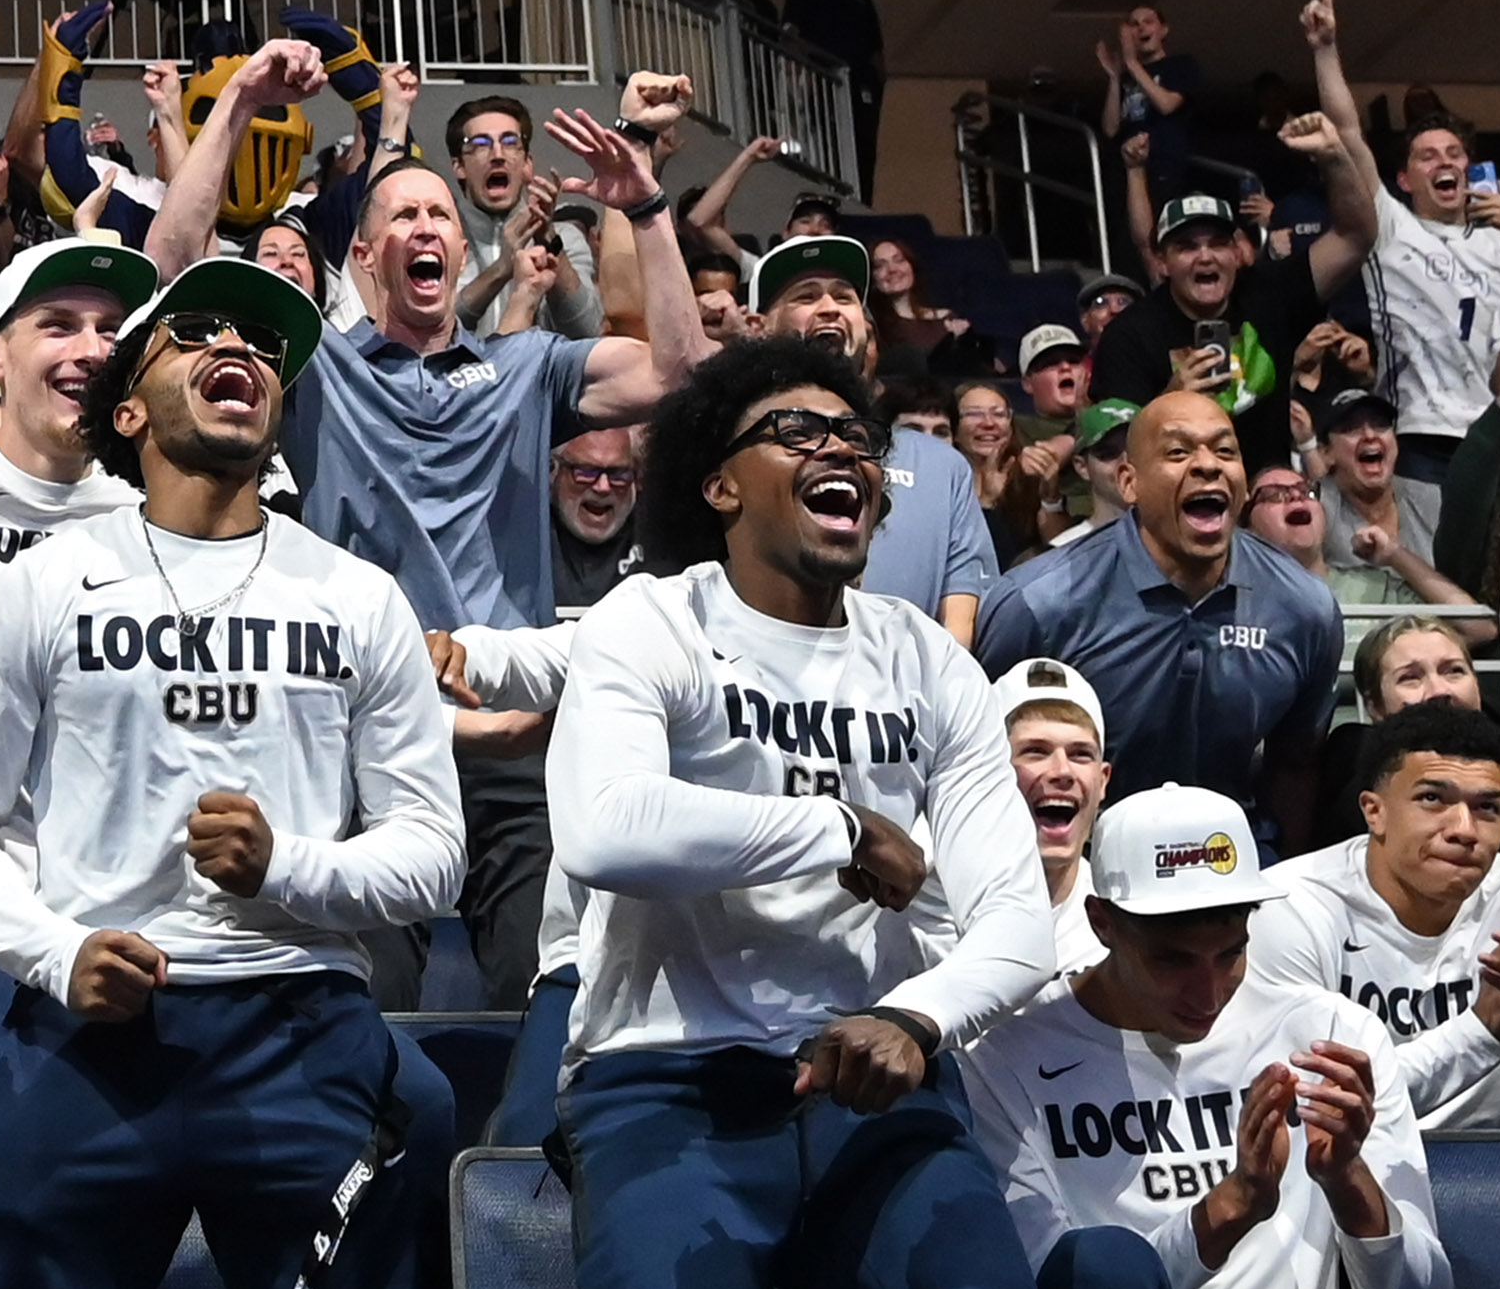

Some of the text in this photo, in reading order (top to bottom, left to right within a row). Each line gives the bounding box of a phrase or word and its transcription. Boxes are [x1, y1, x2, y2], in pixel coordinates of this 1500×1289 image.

[1294, 223, 1322, 235] CBU
[1459, 298, 1475, 341] 1
[447, 362, 497, 388] CBU
[77, 614, 353, 680] LOCK IT IN.
[1219, 624, 1268, 650] CBU
[164, 683, 258, 724] CBU
[723, 683, 836, 759] LOCK
[865, 707, 919, 764] IN.
[1155, 845, 1231, 868] CHAMPIONS
[1044, 1099, 1185, 1159] LOCK
[1185, 1091, 1233, 1151] IT
[1142, 1158, 1230, 1201] CBU
